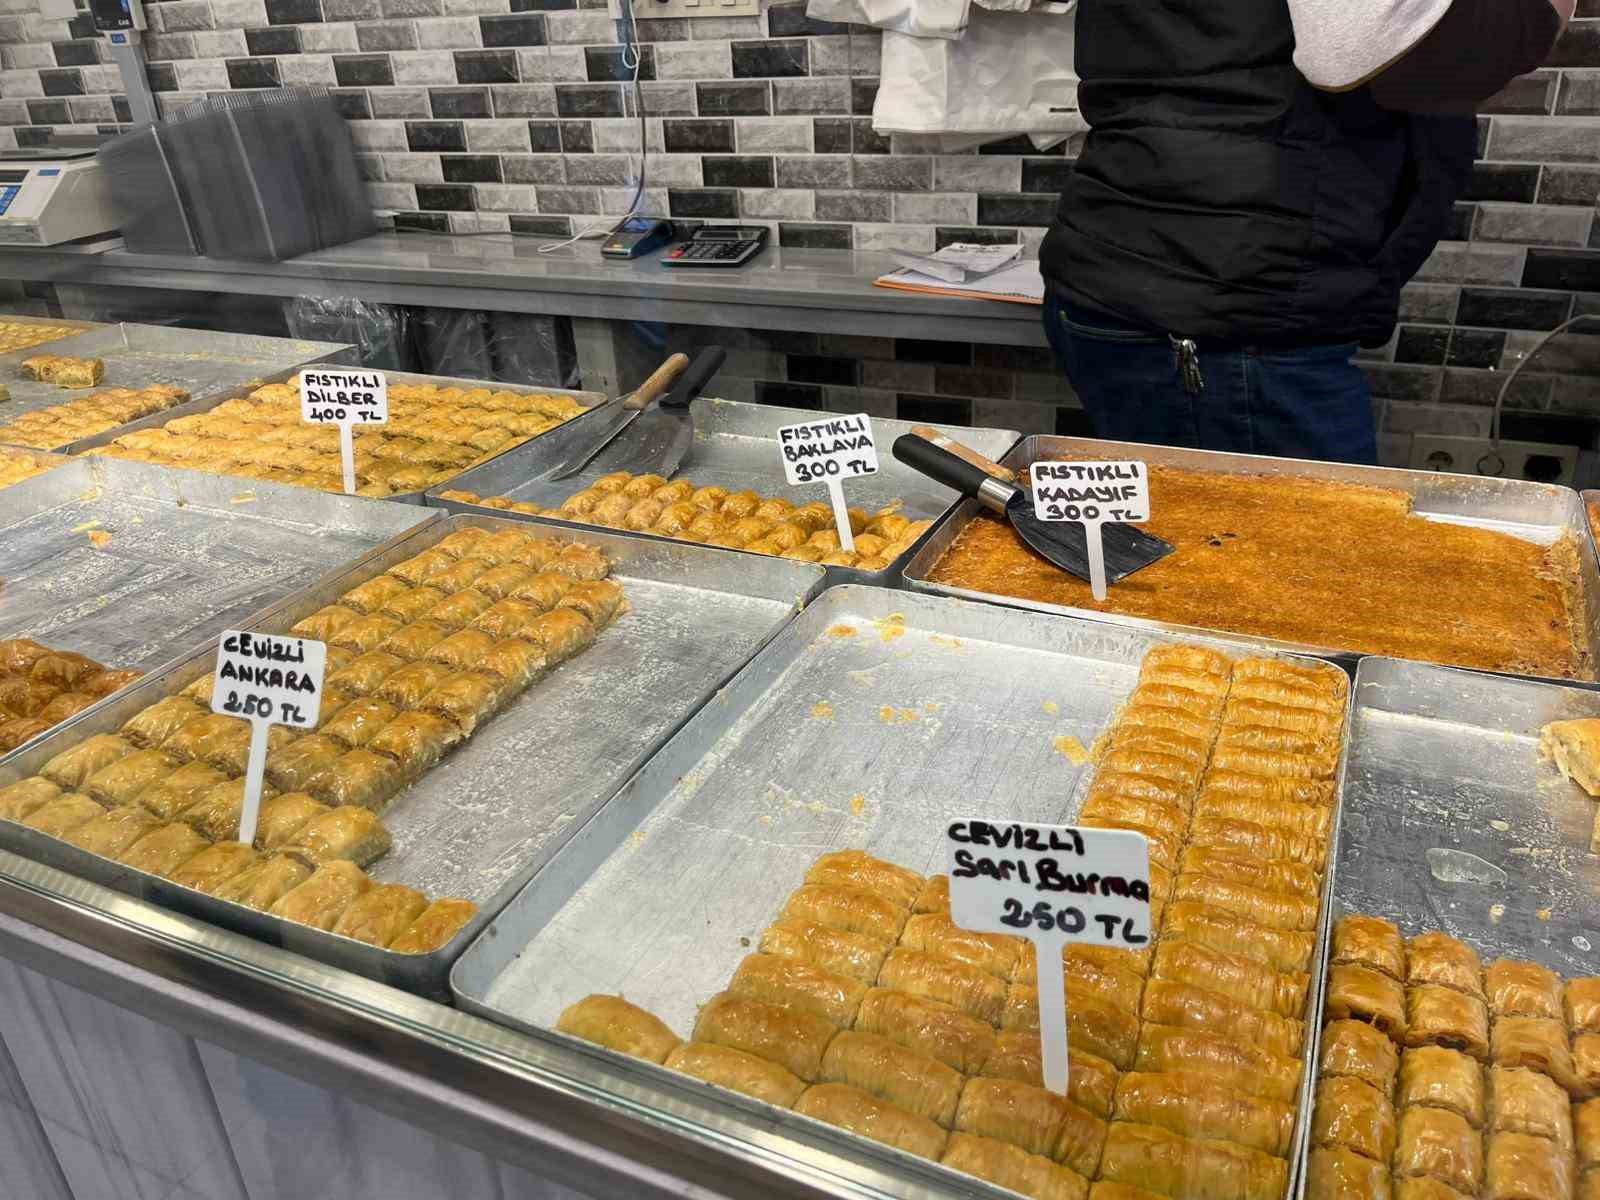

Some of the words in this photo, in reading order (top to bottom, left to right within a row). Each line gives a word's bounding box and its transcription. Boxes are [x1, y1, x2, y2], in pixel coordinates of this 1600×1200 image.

[305, 374, 380, 388] FISTIKLI
[310, 408, 346, 422] 400
[358, 411, 382, 421] TL
[780, 417, 865, 444] FISTIKLI
[784, 435, 873, 462] BAKLAVA
[796, 459, 840, 481] 300
[847, 460, 876, 474] TL
[1036, 464, 1139, 481] FISTIKLI
[1037, 485, 1138, 502] KADAYIF
[1046, 504, 1100, 520] 300
[1109, 509, 1142, 520] TL
[220, 660, 316, 694] ANKARA
[223, 690, 273, 718] 250
[281, 703, 306, 722] TL
[1035, 858, 1150, 903] Burma
[1000, 898, 1086, 934] 250
[1095, 914, 1148, 944] TL
